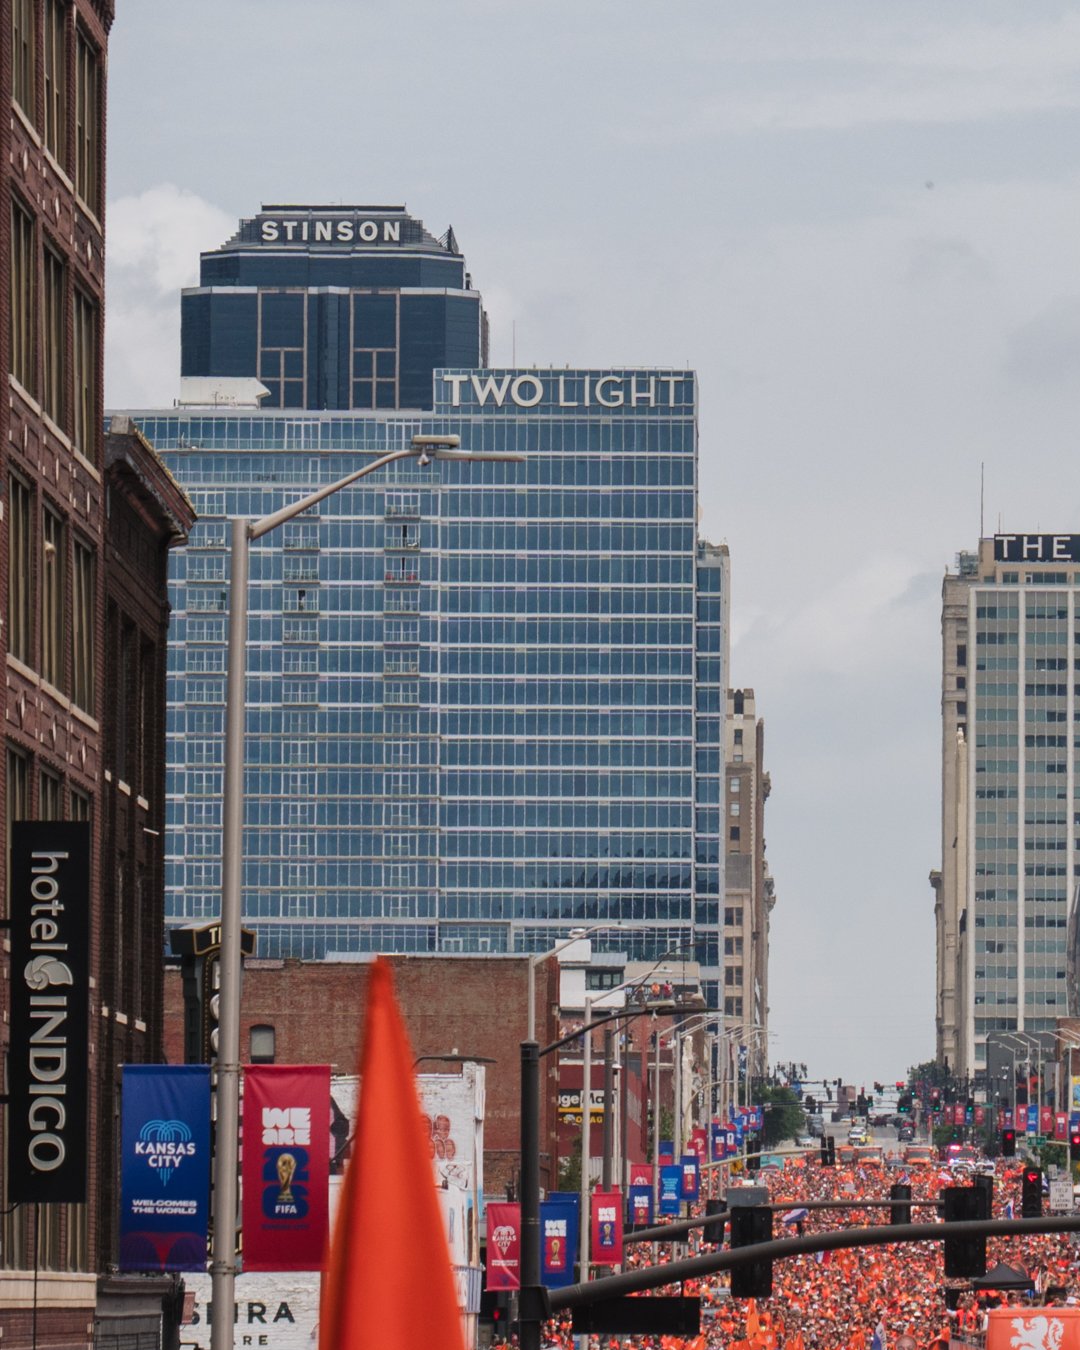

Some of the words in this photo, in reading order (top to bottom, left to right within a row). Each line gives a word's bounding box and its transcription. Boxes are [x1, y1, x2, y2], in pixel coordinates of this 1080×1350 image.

[261, 220, 401, 241] STINSON
[443, 374, 544, 407] TWO
[559, 375, 684, 408] LIGHT
[996, 536, 1072, 559] THE
[30, 851, 69, 951] hotel
[27, 996, 67, 1172] INDIGO
[262, 1107, 311, 1129] WE
[262, 1129, 311, 1145] ARE
[135, 1142, 196, 1155] KANSAS
[148, 1155, 182, 1168] CITY
[132, 1199, 197, 1207] WELCOMES
[156, 1207, 197, 1215] WORLD
[275, 1205, 298, 1214] FIFA
